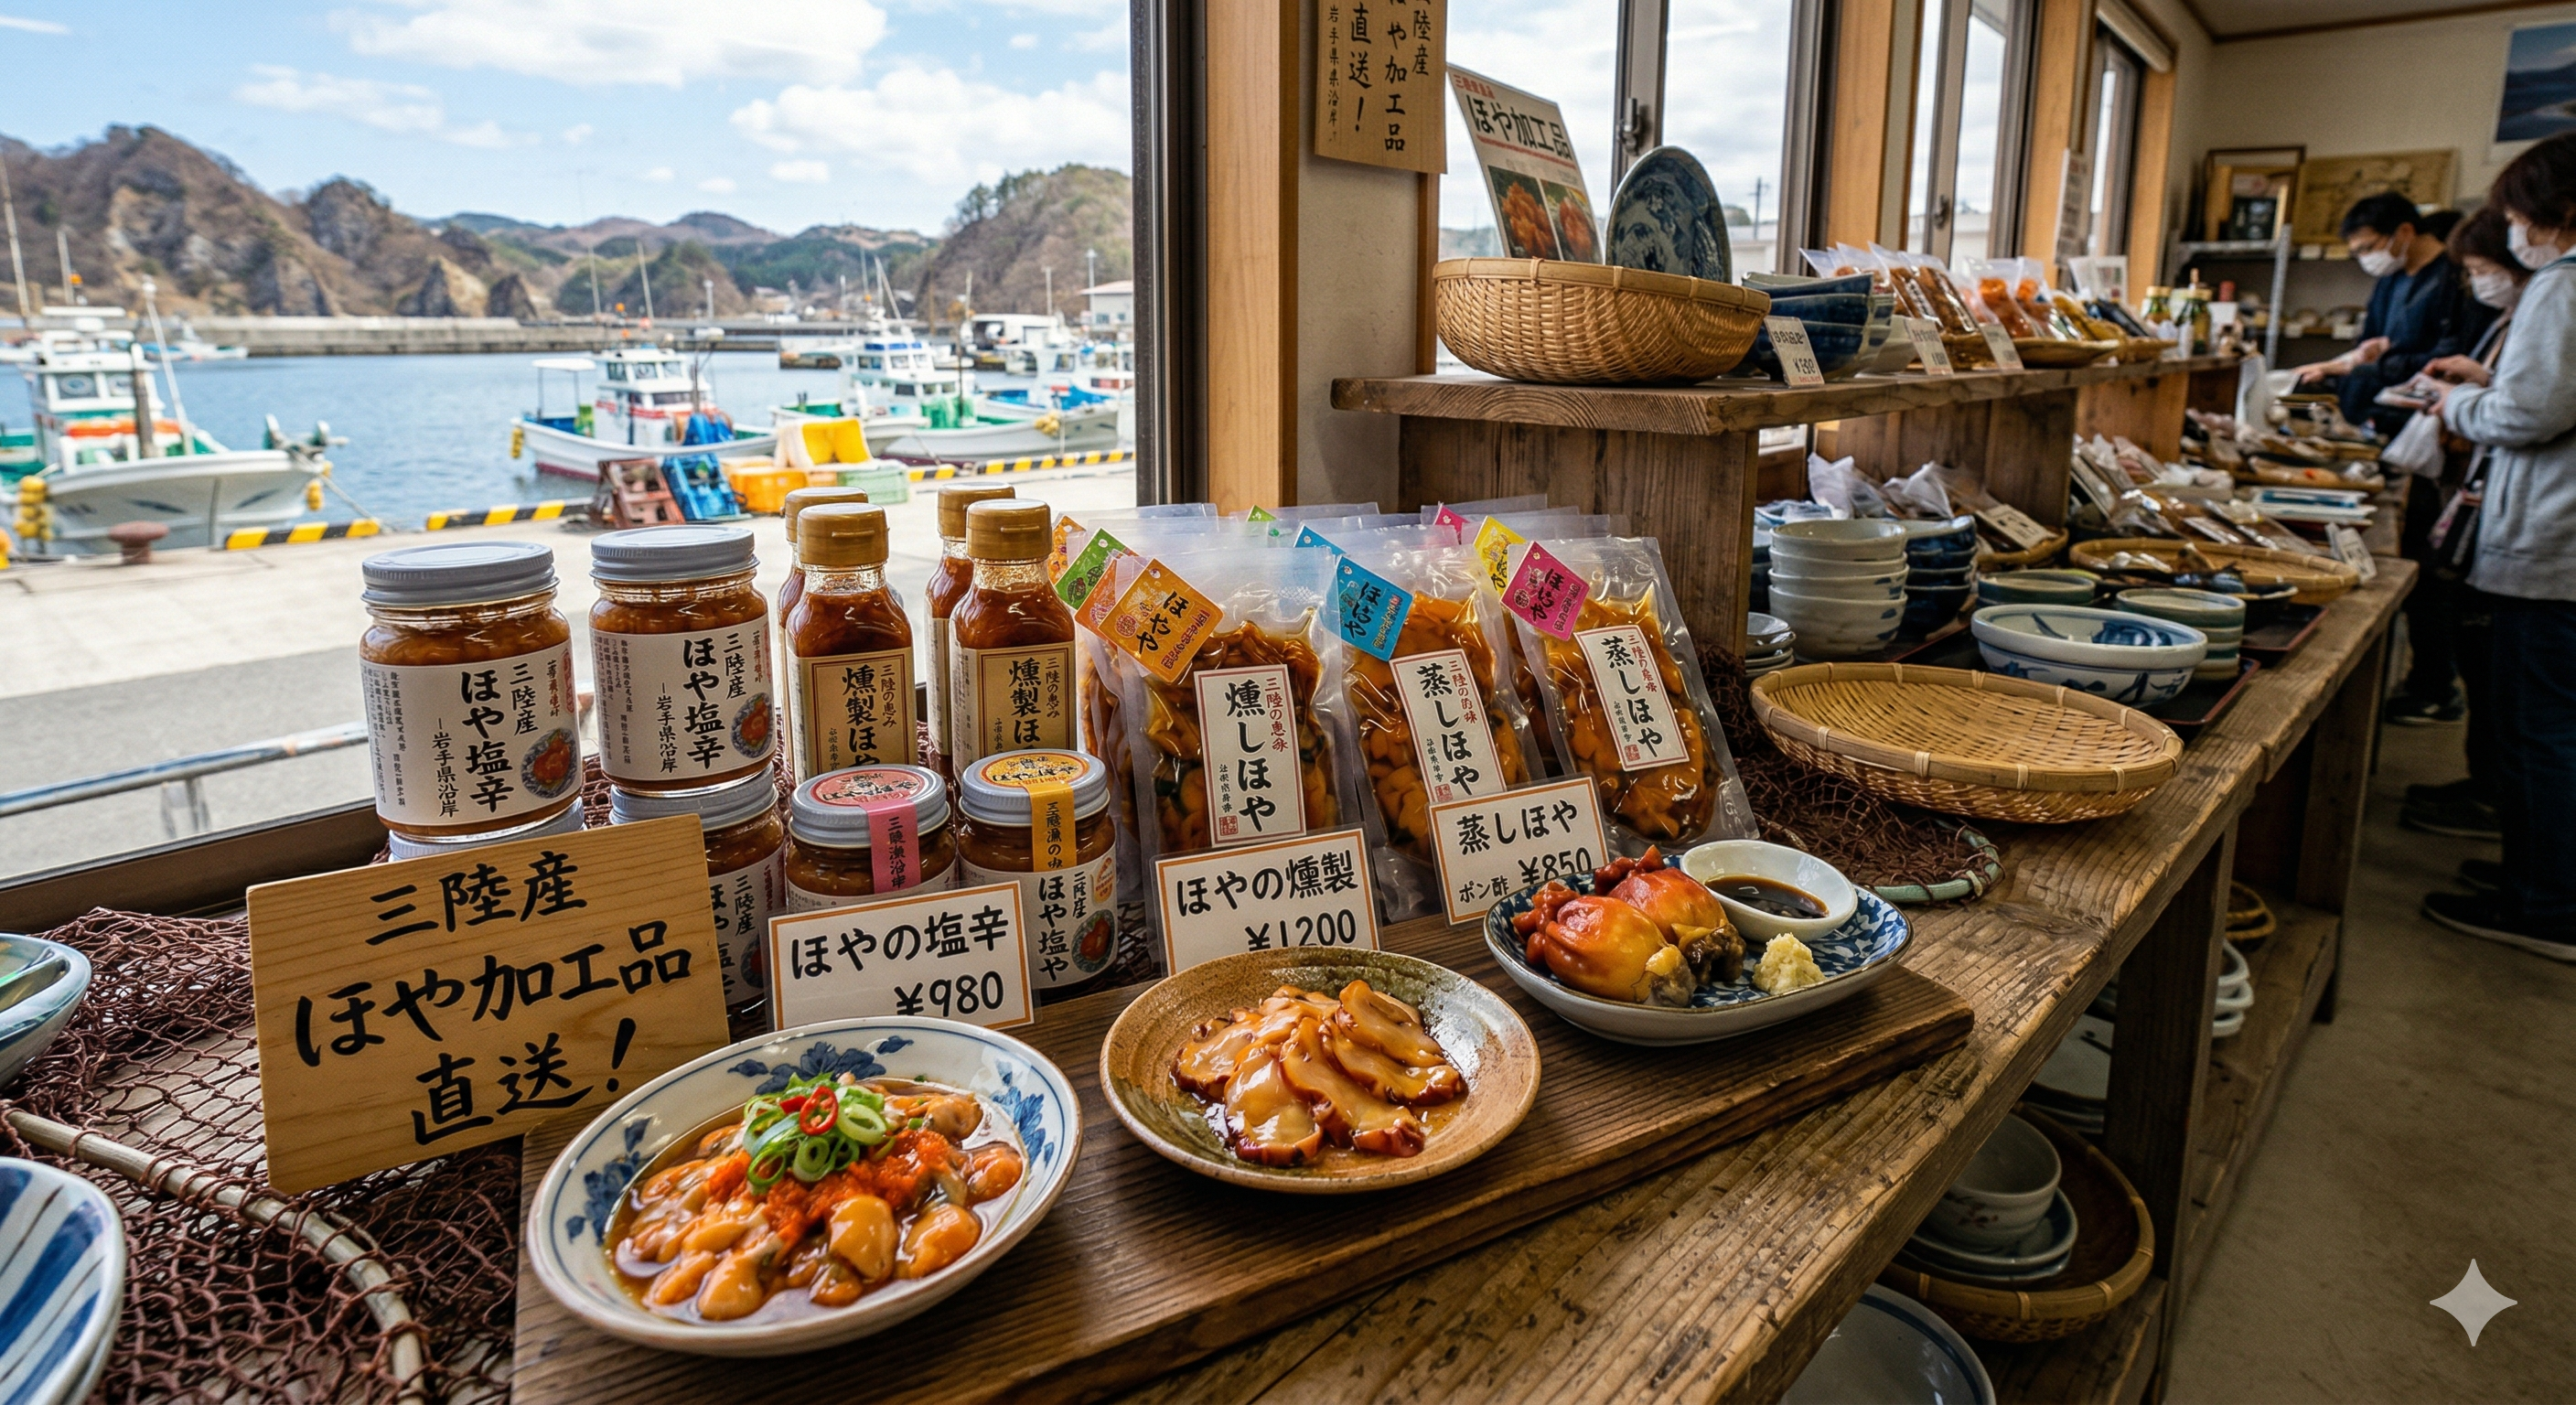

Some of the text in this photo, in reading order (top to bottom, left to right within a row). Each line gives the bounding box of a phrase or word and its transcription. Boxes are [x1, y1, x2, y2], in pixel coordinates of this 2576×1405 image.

[1348, 2, 1372, 133] 直送！
[1384, 0, 1407, 152] や加工品
[1412, 0, 1431, 77] 陸産
[1465, 94, 1573, 160] ほや加工品
[509, 662, 539, 736] 三陸産
[682, 637, 725, 770] ほや塩辛
[723, 632, 747, 701] 三陸産
[1008, 657, 1042, 749] 燻製ほ
[1601, 636, 1663, 758] 蒸しほや
[460, 669, 515, 813] ほや塩辛
[1224, 678, 1277, 833] 燻しほや
[1416, 662, 1480, 797] 蒸しほや
[1456, 799, 1578, 855] 蒸しほや
[1518, 847, 1593, 885] ¥850
[366, 850, 587, 946] 三陸産
[734, 874, 756, 937] 三陸産
[1176, 849, 1358, 917] ほやの燻製
[1459, 874, 1509, 904] ポン酢
[791, 905, 1009, 980] ほやの塩辛
[1037, 875, 1069, 981] ほや塩や
[1244, 908, 1357, 952] ¥1200
[295, 920, 692, 1067] ほや加工品
[894, 971, 1004, 1017] ¥980
[411, 1017, 637, 1145] 直送！
